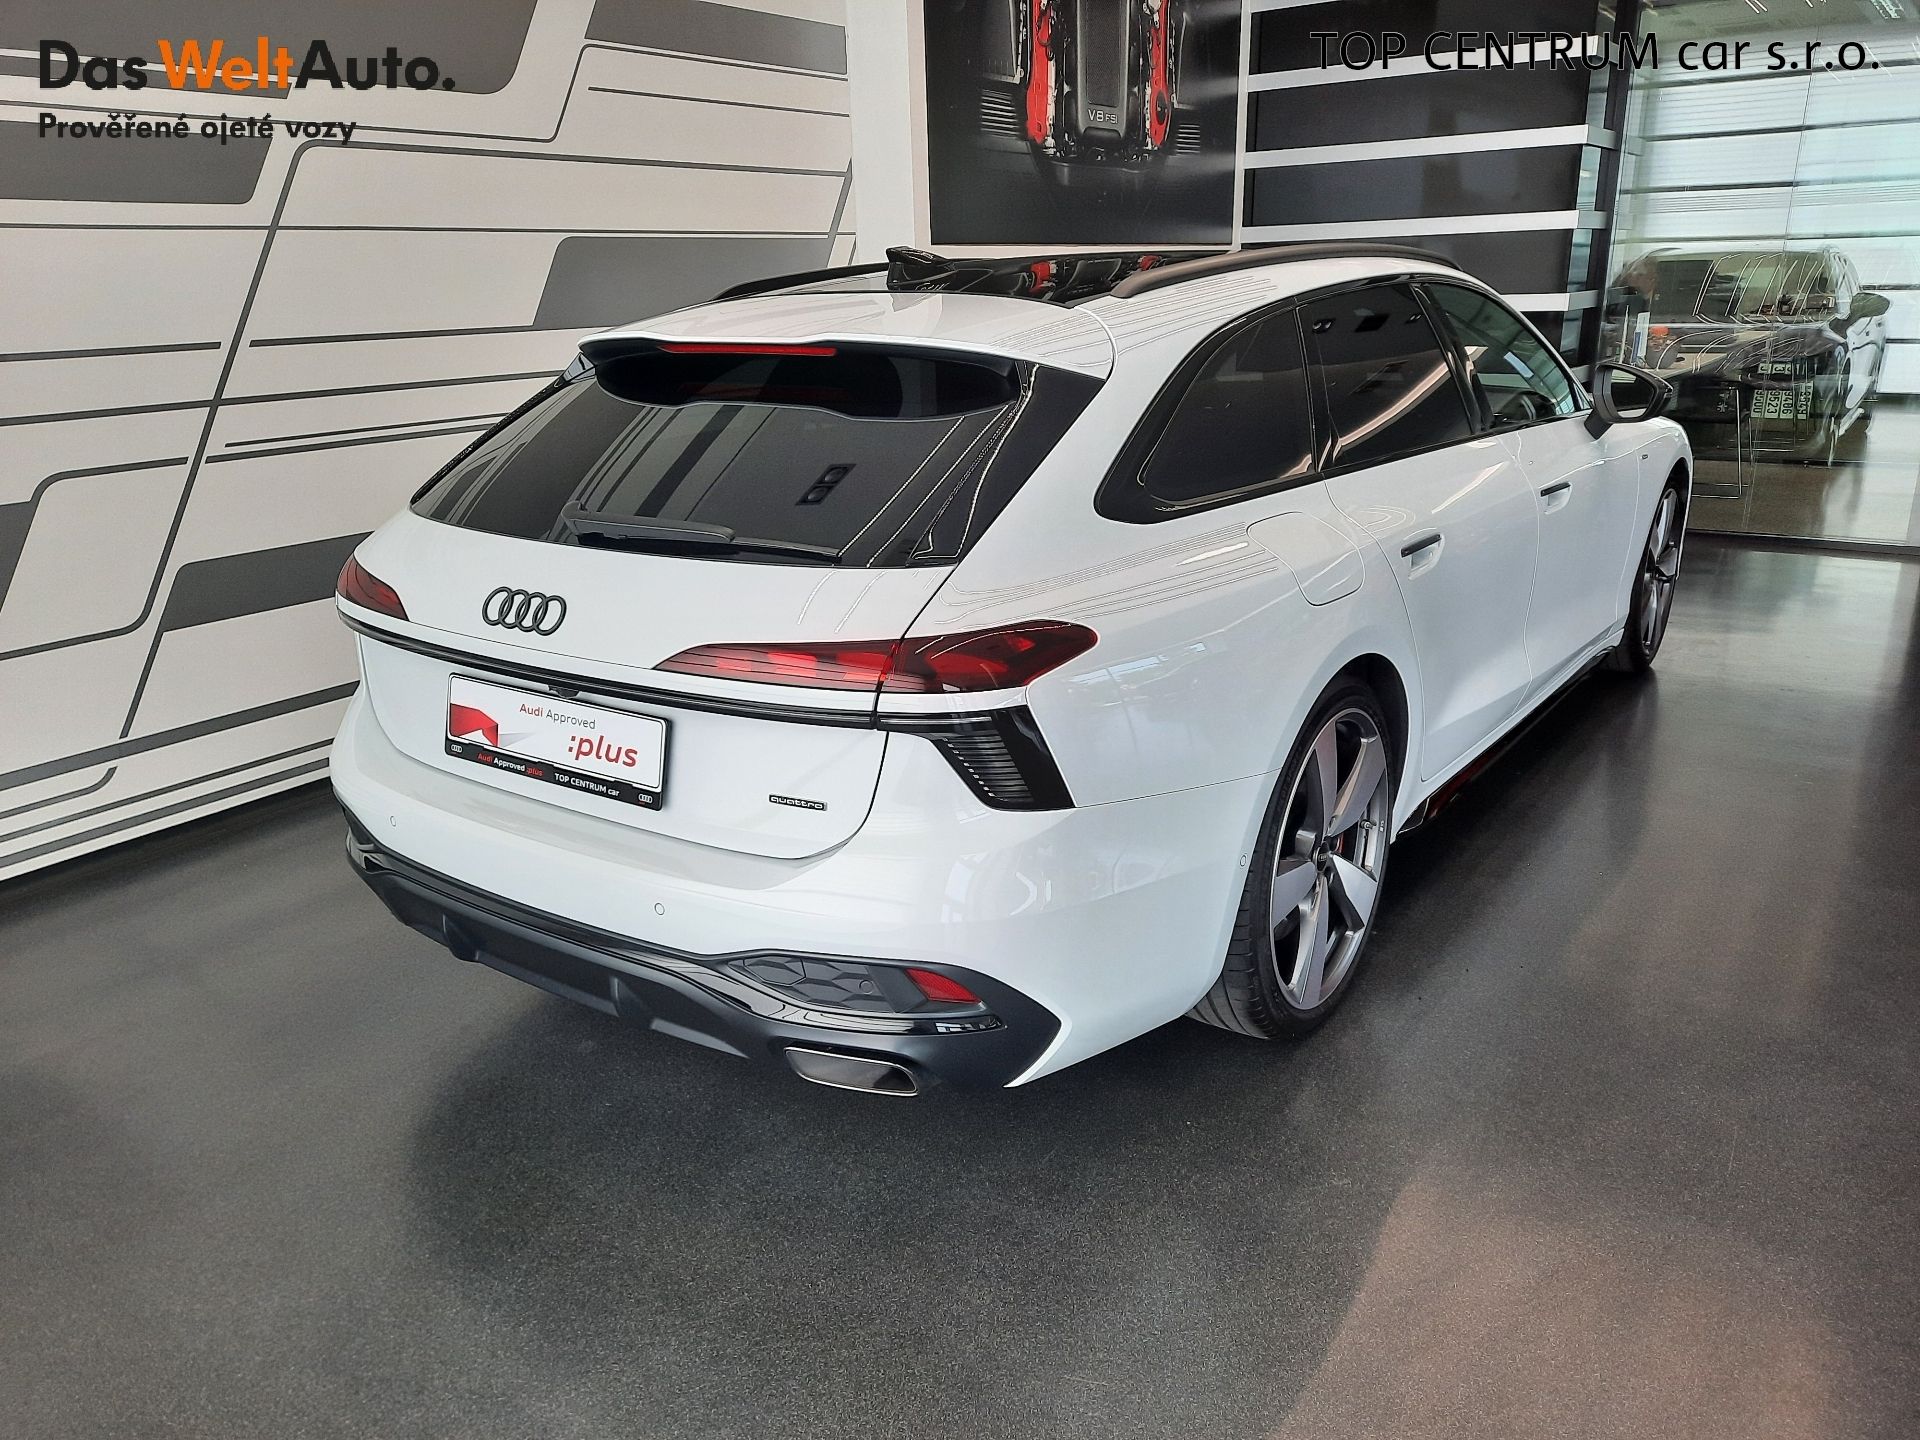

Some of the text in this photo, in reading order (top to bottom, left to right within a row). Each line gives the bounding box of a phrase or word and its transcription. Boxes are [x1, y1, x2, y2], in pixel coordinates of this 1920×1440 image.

[1088, 109, 1118, 124] V8 FSI
[519, 703, 596, 730] Audi Approved
[568, 735, 638, 767] :plus
[477, 753, 493, 763] Audi
[494, 757, 526, 772] Approved
[554, 773, 620, 797] TOP CENTRUM car
[769, 795, 824, 810] quattro
